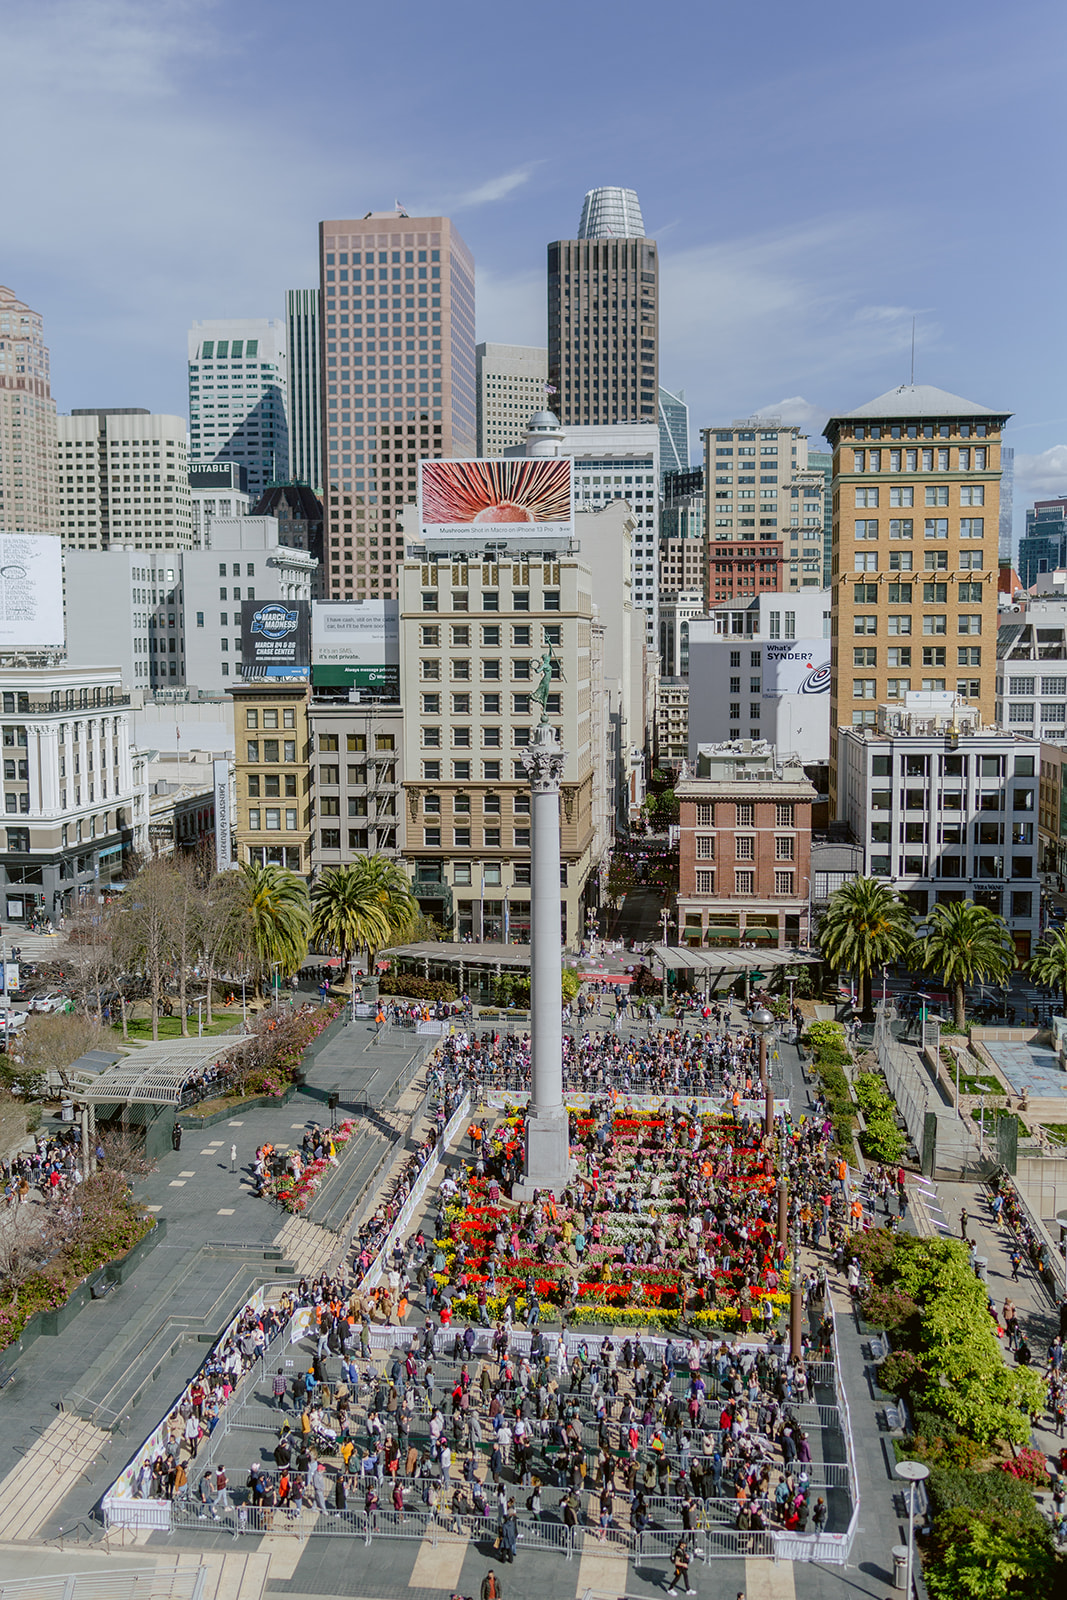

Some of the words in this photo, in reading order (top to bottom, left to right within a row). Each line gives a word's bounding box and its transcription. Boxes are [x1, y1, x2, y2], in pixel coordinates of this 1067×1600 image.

[262, 613, 286, 621] MARCH
[264, 620, 297, 628] MADNESS
[767, 652, 813, 660] SYNDER?
[218, 783, 226, 821] JOHNSTON
